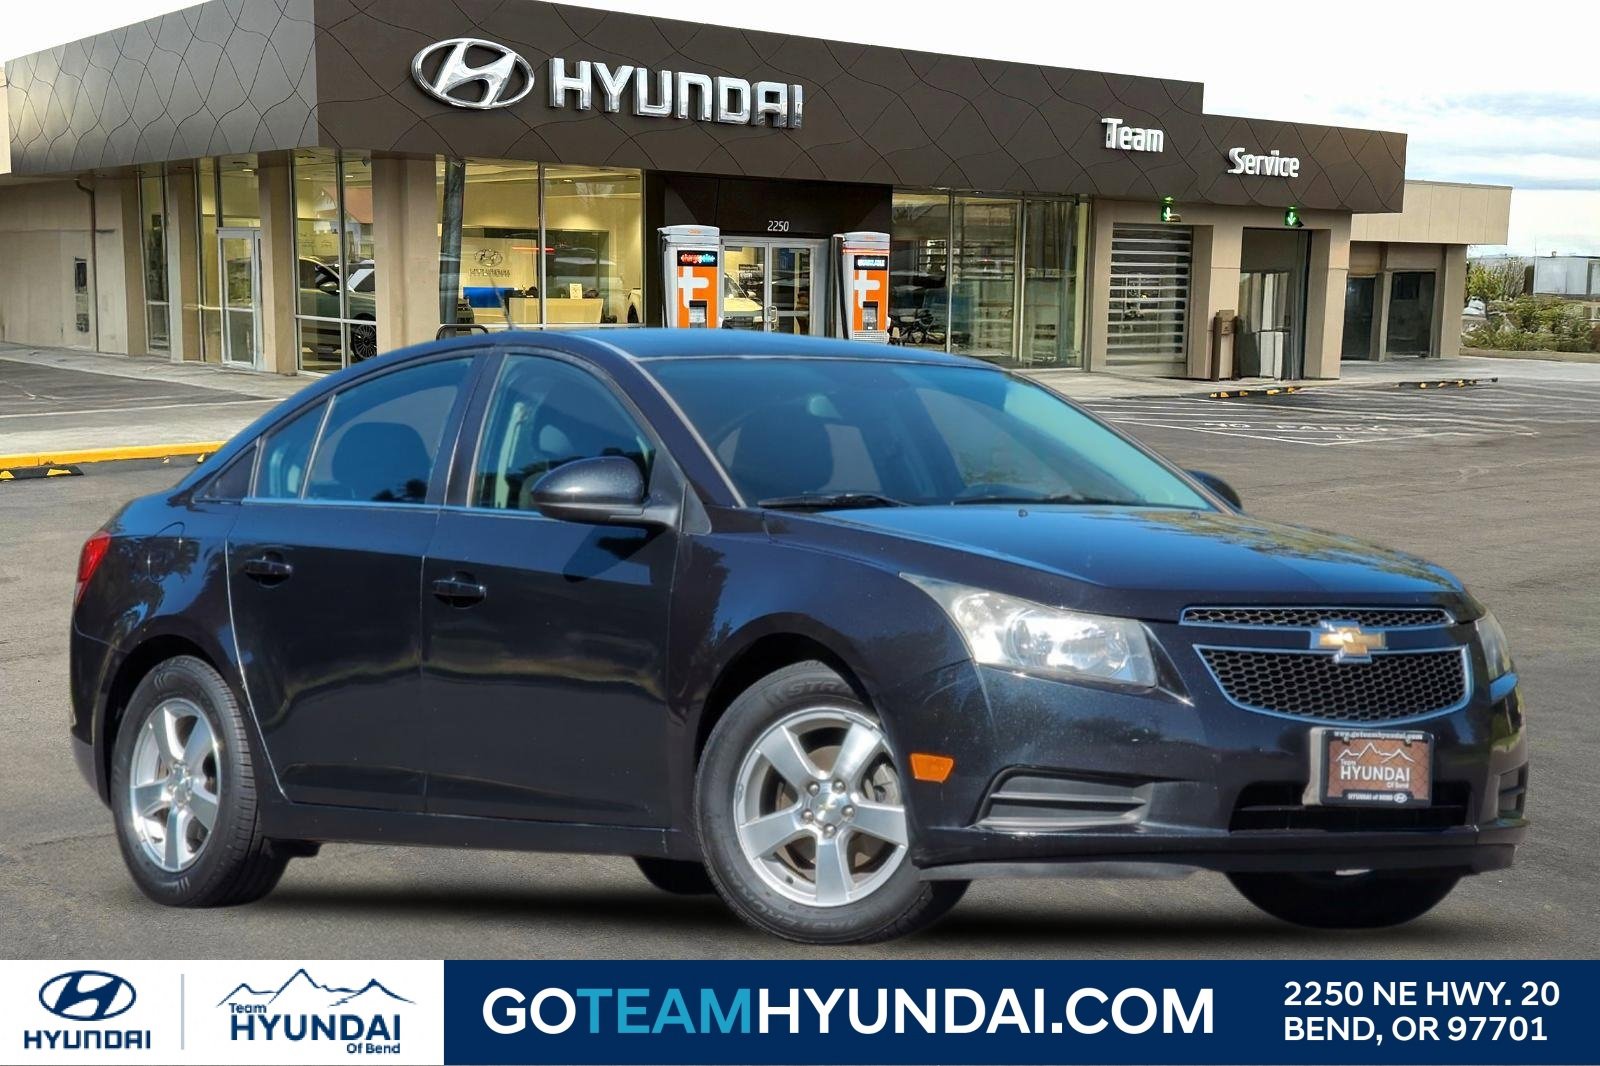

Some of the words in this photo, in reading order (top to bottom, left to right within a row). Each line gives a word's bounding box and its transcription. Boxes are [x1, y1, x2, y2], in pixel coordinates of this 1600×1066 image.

[549, 56, 804, 129] HYUNDAI
[1101, 117, 1164, 153] Team
[1227, 147, 1300, 178] Service
[767, 220, 789, 232] 2250
[1340, 765, 1410, 782] HYUNDAI
